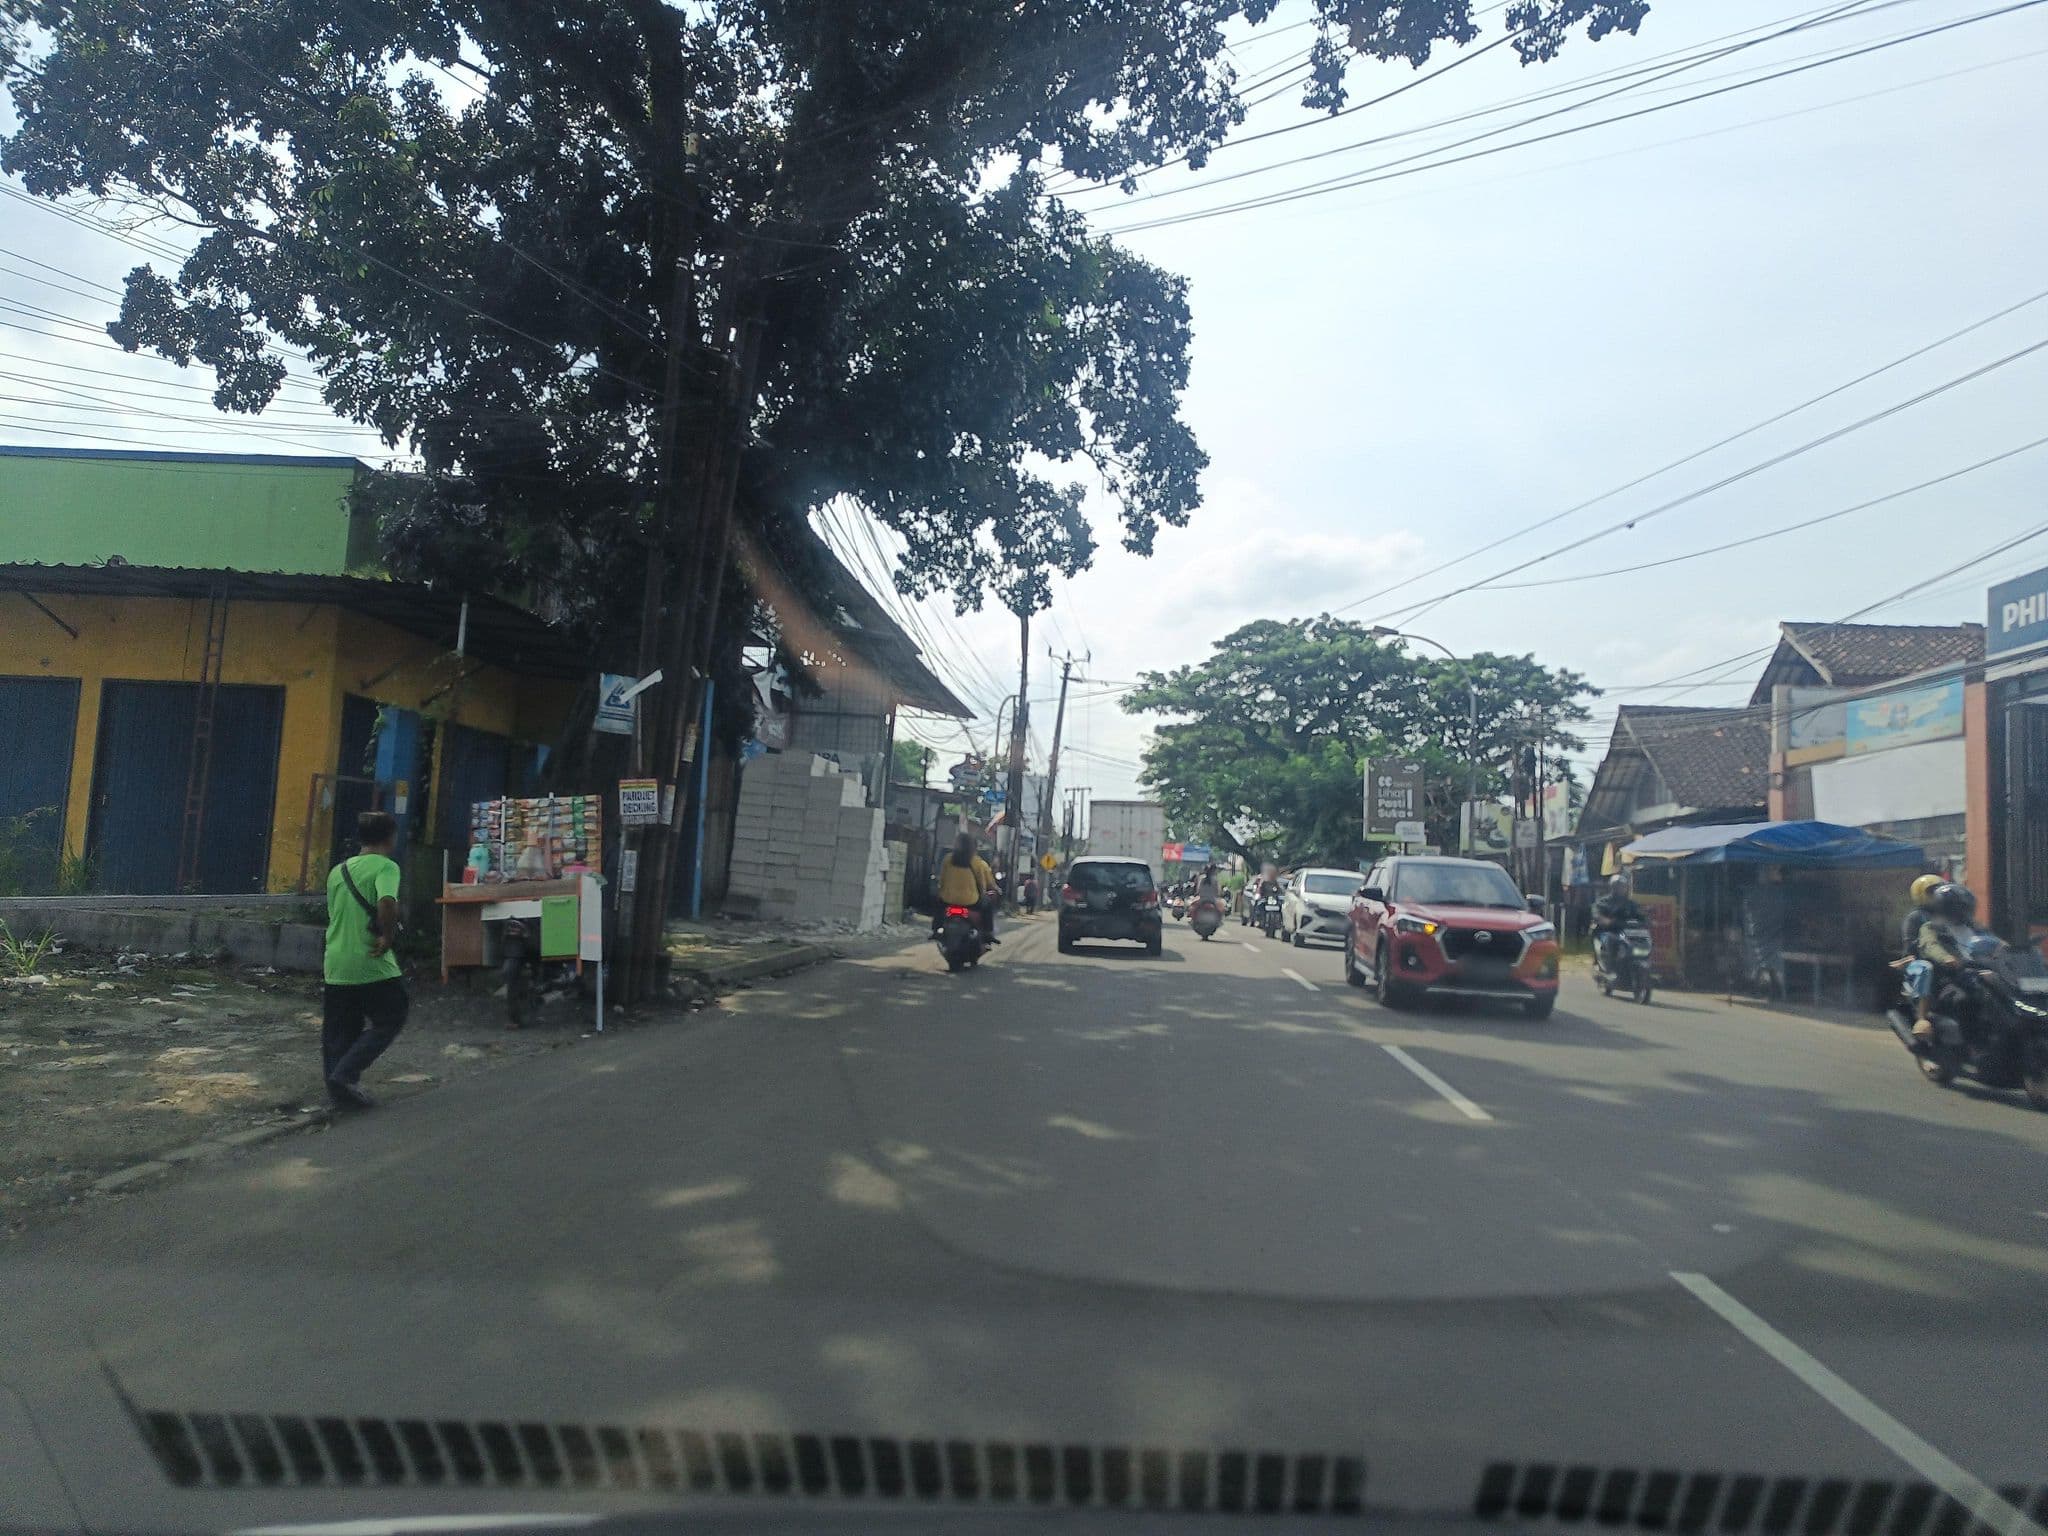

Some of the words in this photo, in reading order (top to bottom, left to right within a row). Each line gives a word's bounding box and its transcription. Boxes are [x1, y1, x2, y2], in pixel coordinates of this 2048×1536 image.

[2002, 591, 2048, 633] PHI
[1378, 798, 1406, 808] Pasti
[1378, 808, 1406, 818] Suka
